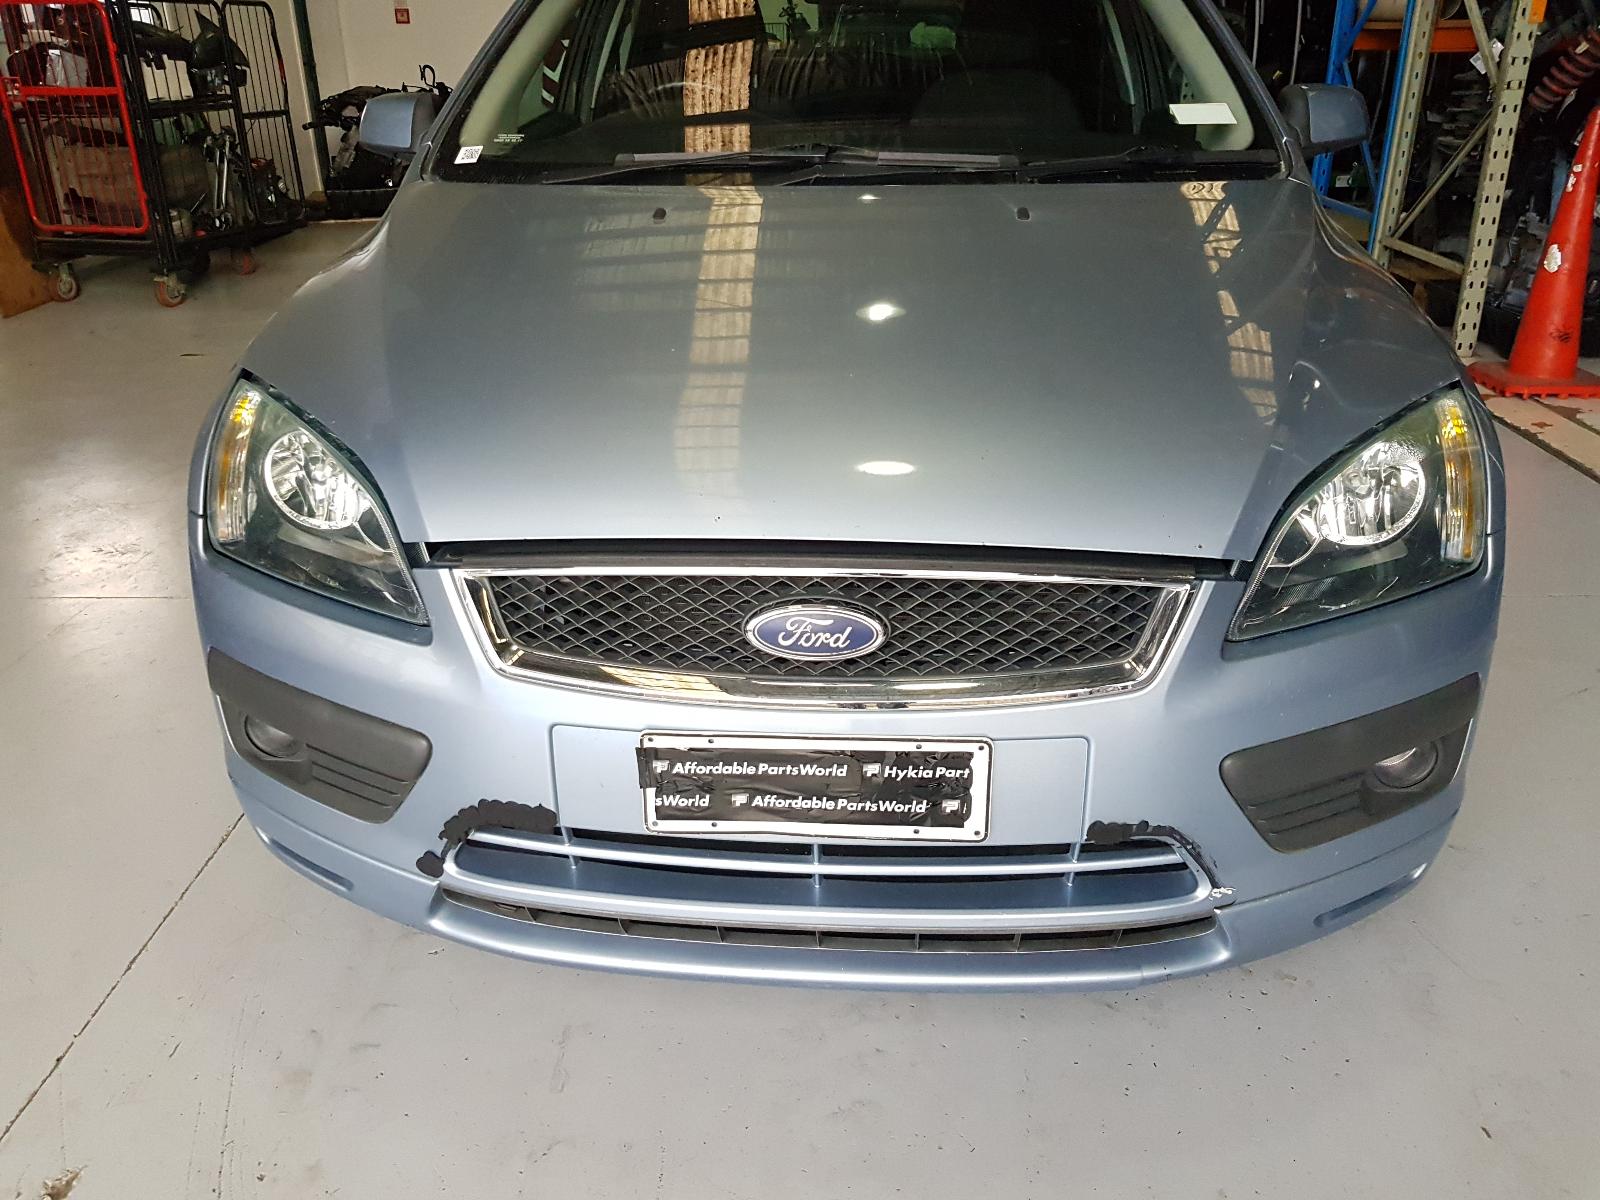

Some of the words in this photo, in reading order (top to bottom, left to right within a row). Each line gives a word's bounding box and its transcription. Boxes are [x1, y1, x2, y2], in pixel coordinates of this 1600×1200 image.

[778, 616, 852, 648] Ford
[672, 761, 756, 775] Affordable
[884, 766, 934, 781] Hykia
[935, 767, 970, 779] Part
[752, 795, 836, 810] Affordable
